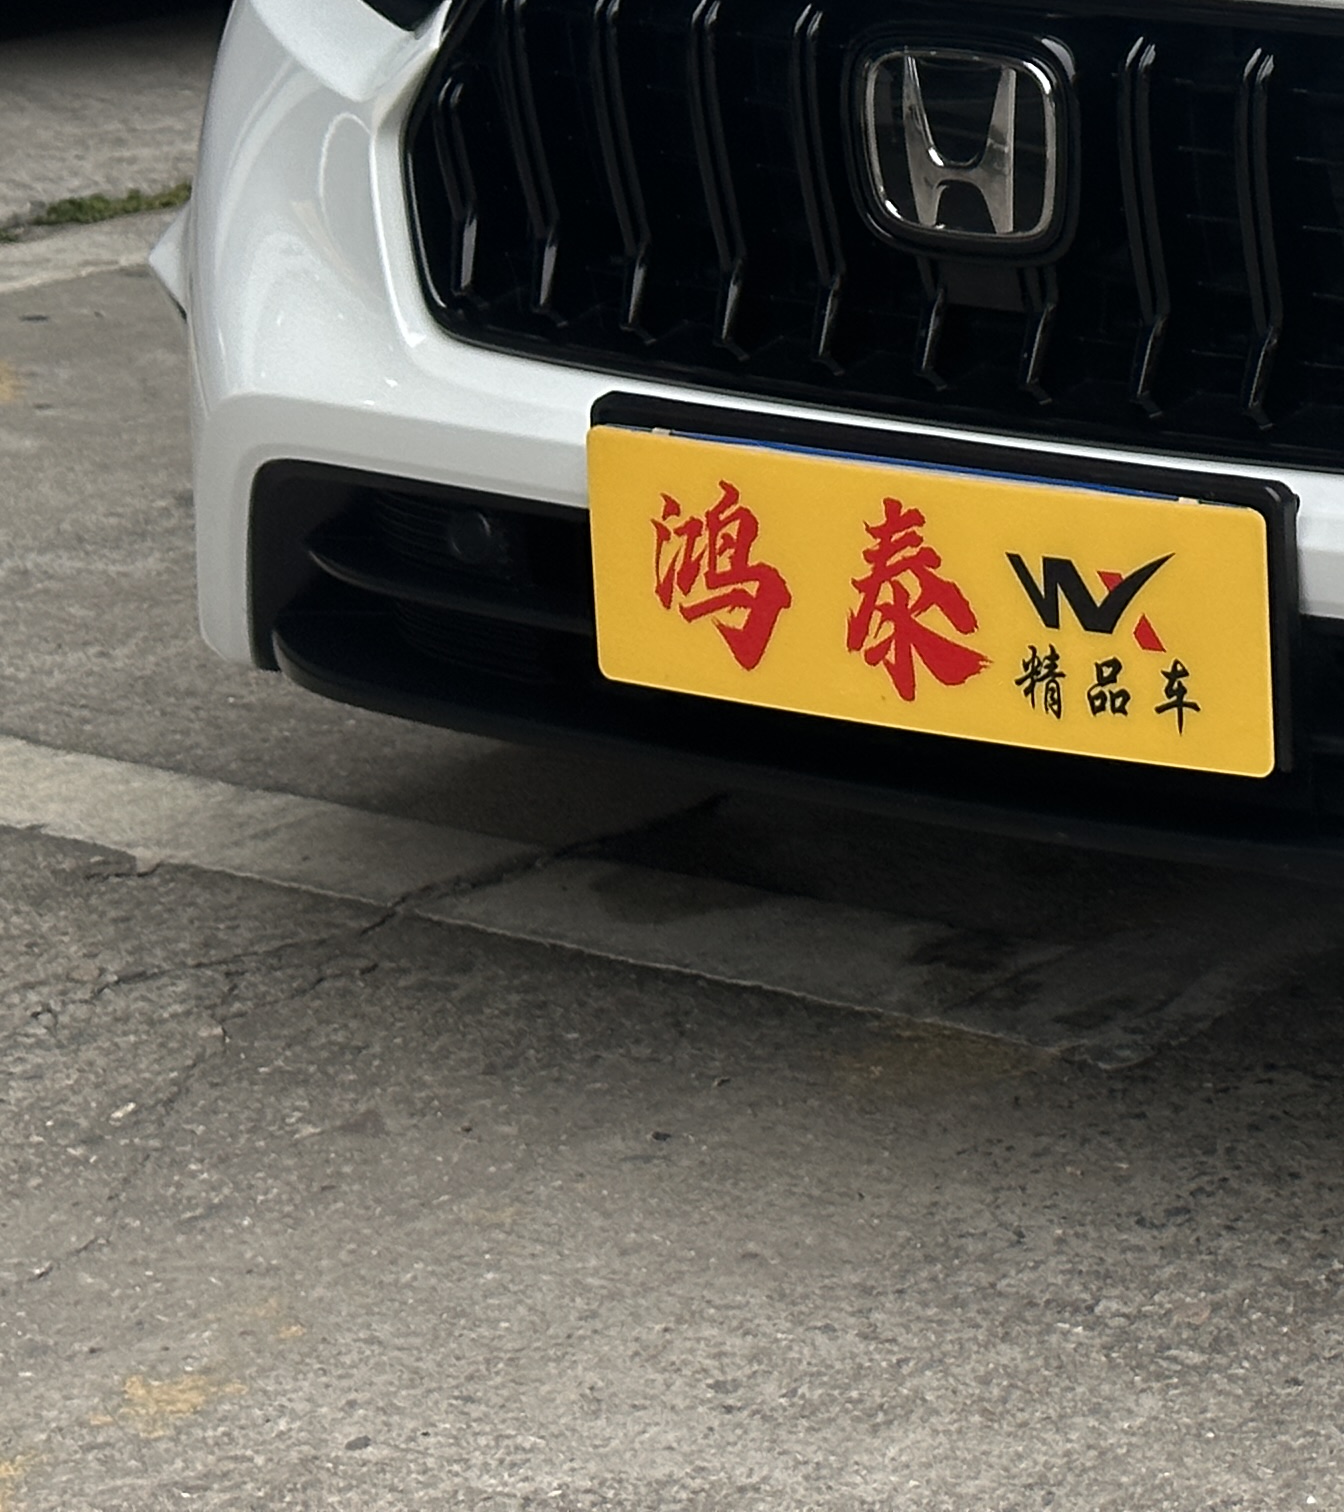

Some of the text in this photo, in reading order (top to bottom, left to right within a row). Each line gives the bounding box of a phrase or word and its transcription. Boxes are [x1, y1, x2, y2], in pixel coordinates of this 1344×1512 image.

[650, 479, 992, 702] 鸿泰
[1014, 644, 1202, 736] 精品车
